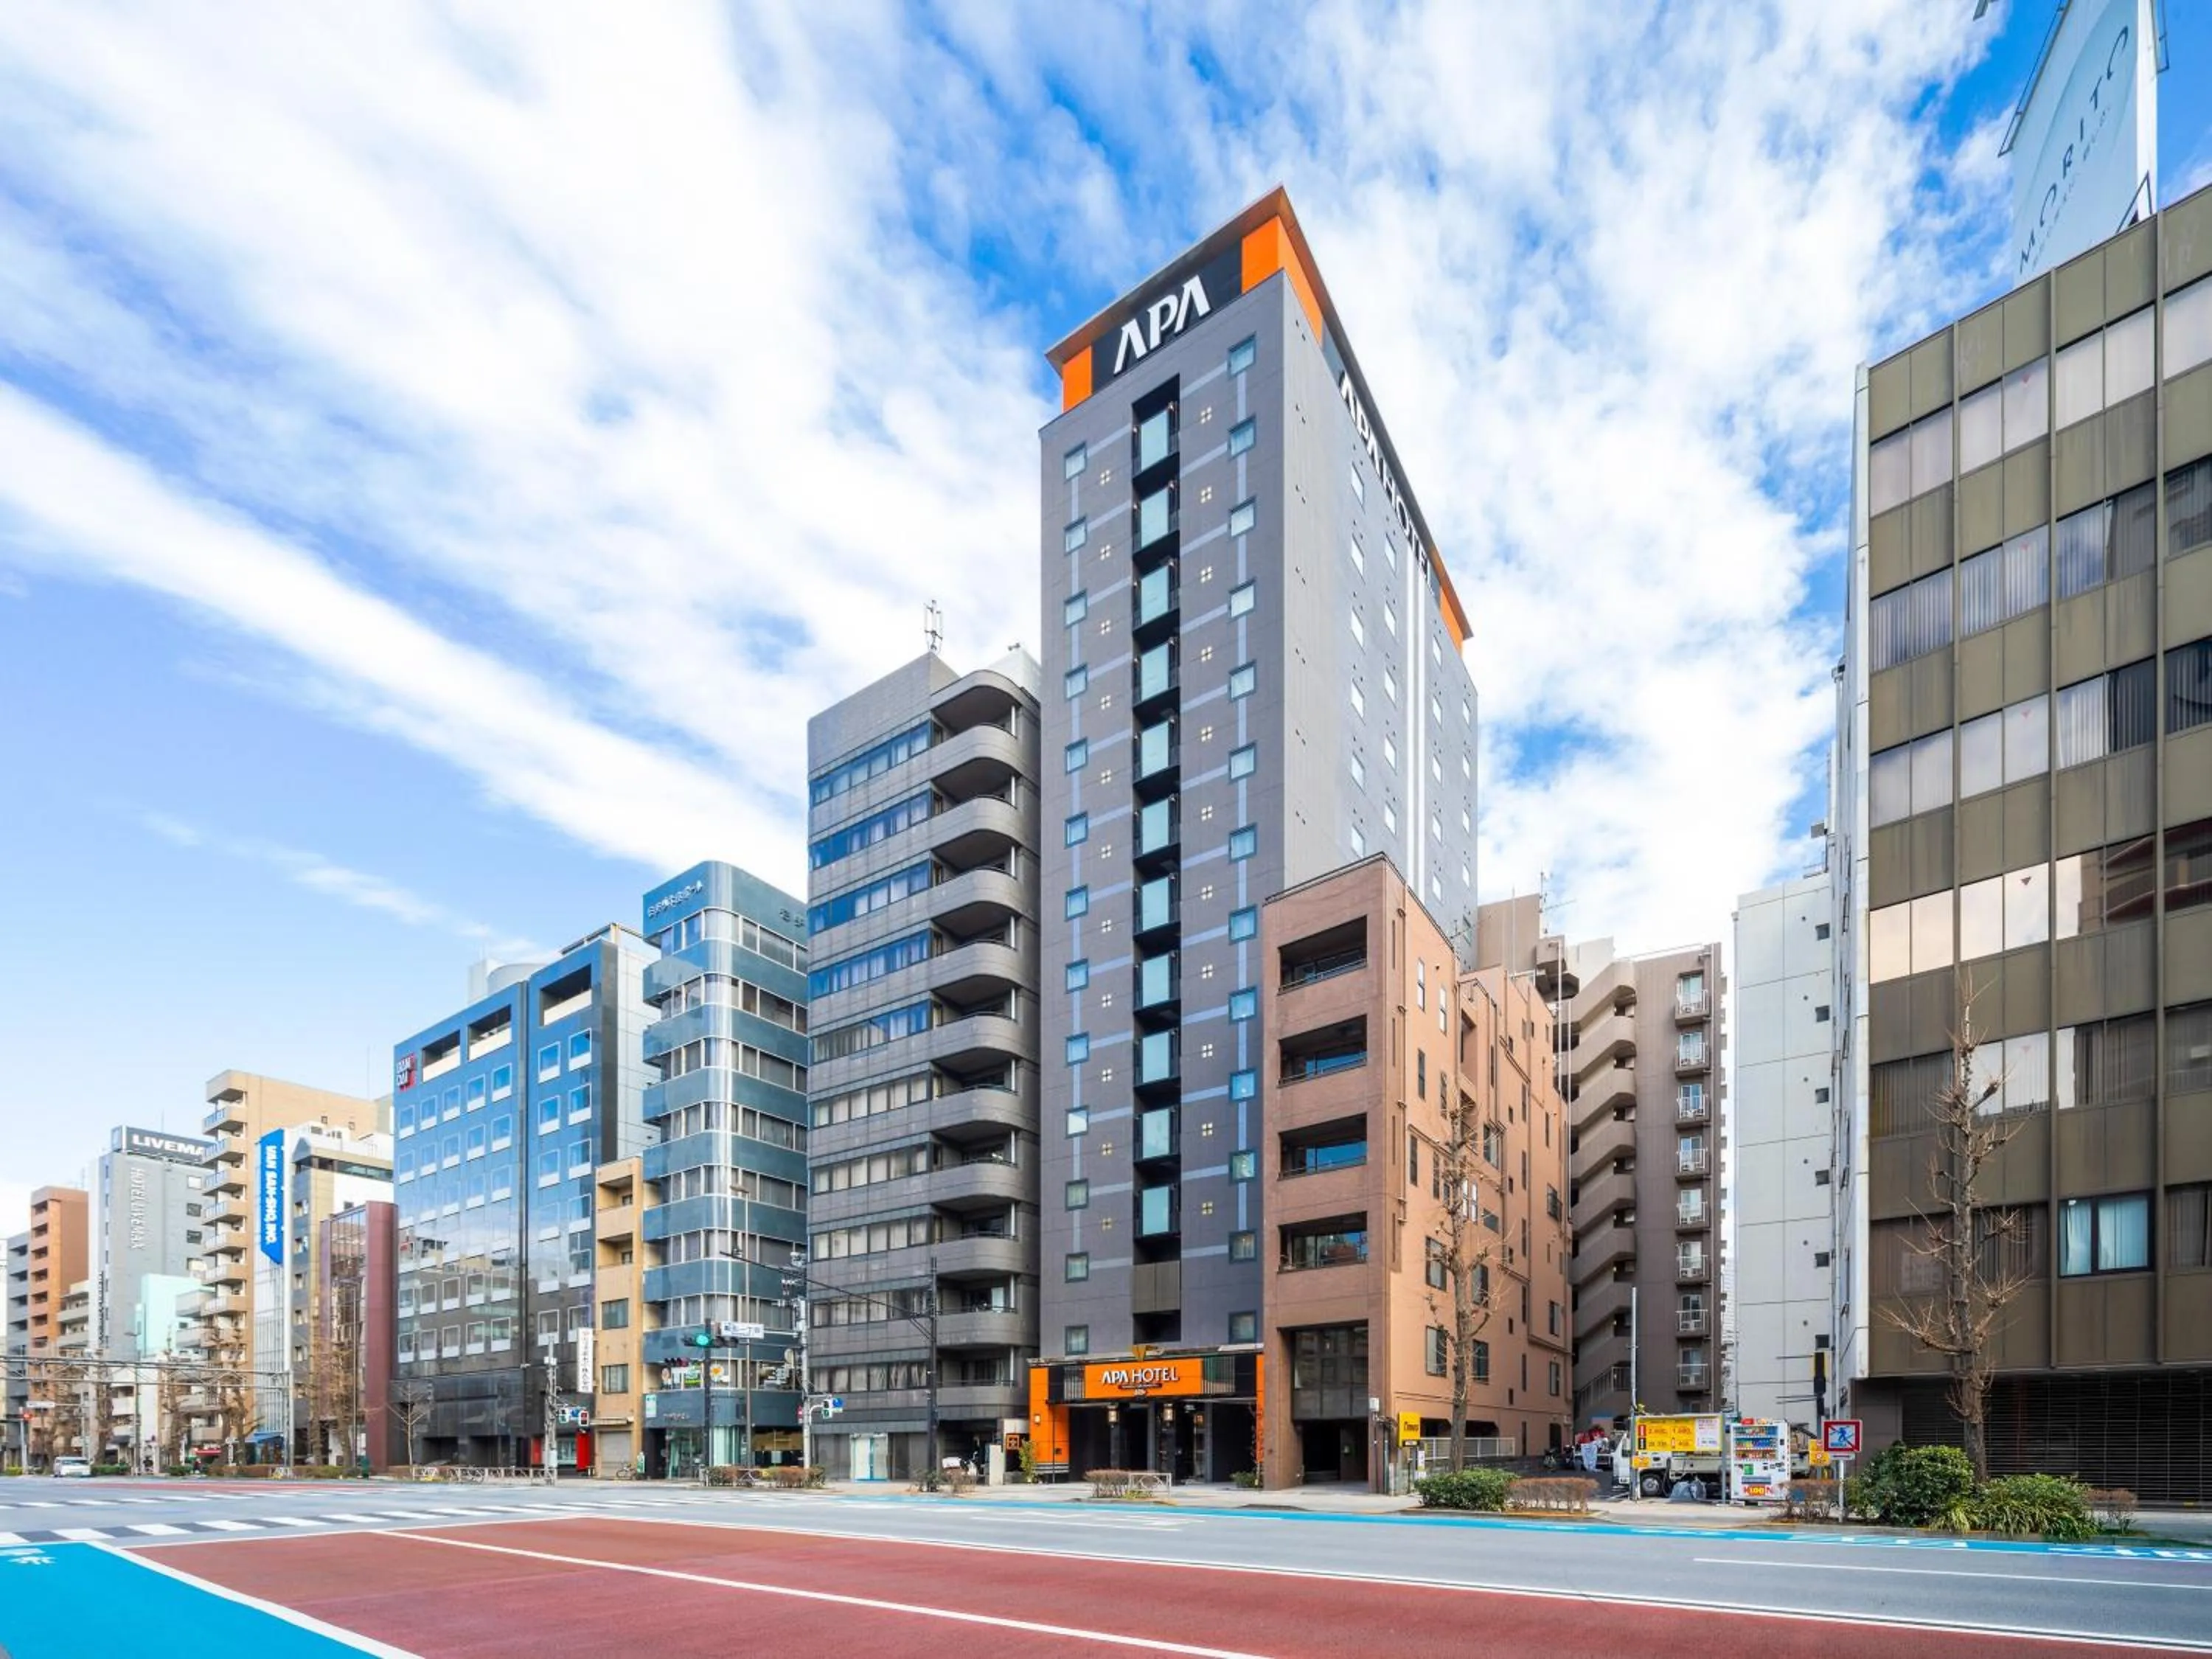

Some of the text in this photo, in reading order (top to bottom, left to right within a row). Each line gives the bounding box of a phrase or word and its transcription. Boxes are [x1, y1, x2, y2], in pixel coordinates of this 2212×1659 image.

[1113, 274, 1211, 375] APA
[1102, 1366, 1180, 1384] APA HOTEL
